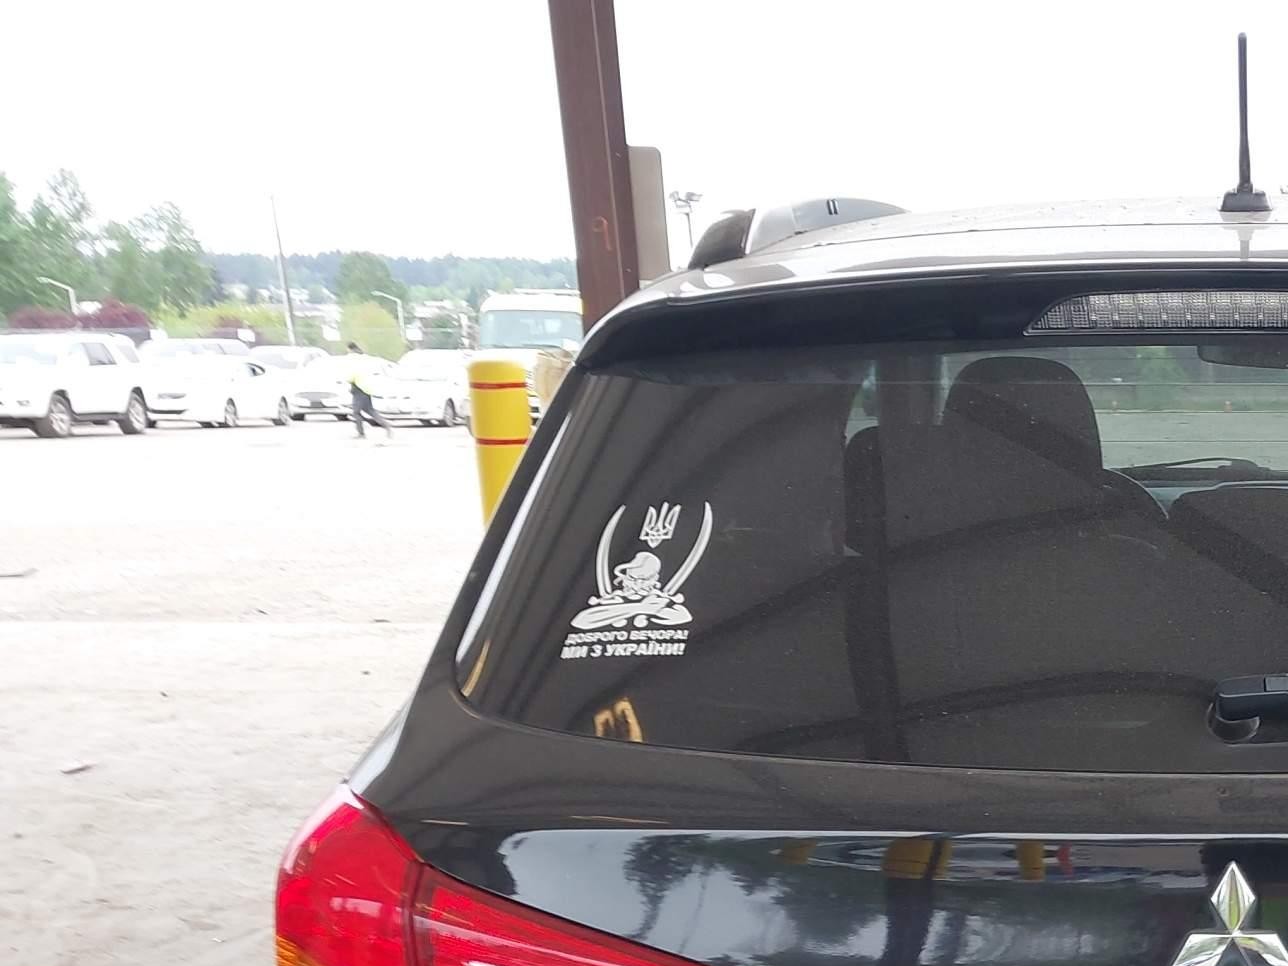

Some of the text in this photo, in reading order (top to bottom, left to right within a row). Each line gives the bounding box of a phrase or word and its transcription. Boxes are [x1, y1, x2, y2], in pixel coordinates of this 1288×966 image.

[564, 630, 628, 645] ДОБРОГО
[560, 645, 588, 659] МИ
[604, 640, 686, 656] УКРАЇНИ!
